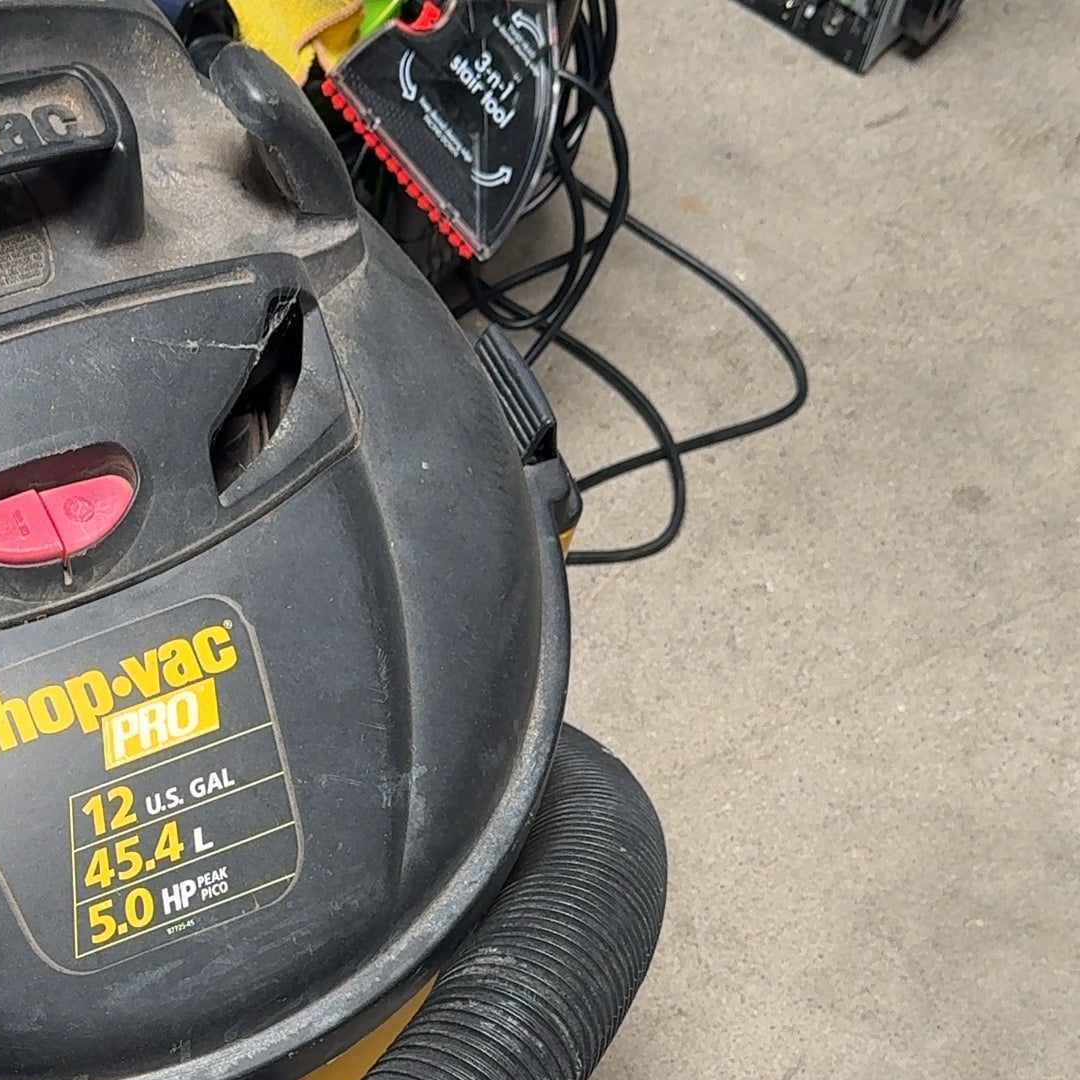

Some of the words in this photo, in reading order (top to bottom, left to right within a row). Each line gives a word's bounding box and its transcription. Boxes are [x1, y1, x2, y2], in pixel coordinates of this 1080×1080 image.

[450, 54, 484, 94] stair
[481, 90, 516, 129] tool
[111, 690, 199, 760] PRO
[82, 786, 137, 836] 12
[145, 787, 184, 815] U.S.
[189, 768, 235, 798] GAL
[85, 821, 184, 889] 45.4
[194, 827, 214, 853] L
[88, 888, 155, 943] 5.0
[161, 881, 197, 915] HP
[198, 867, 228, 888] PEAK
[200, 881, 229, 901] PICO
